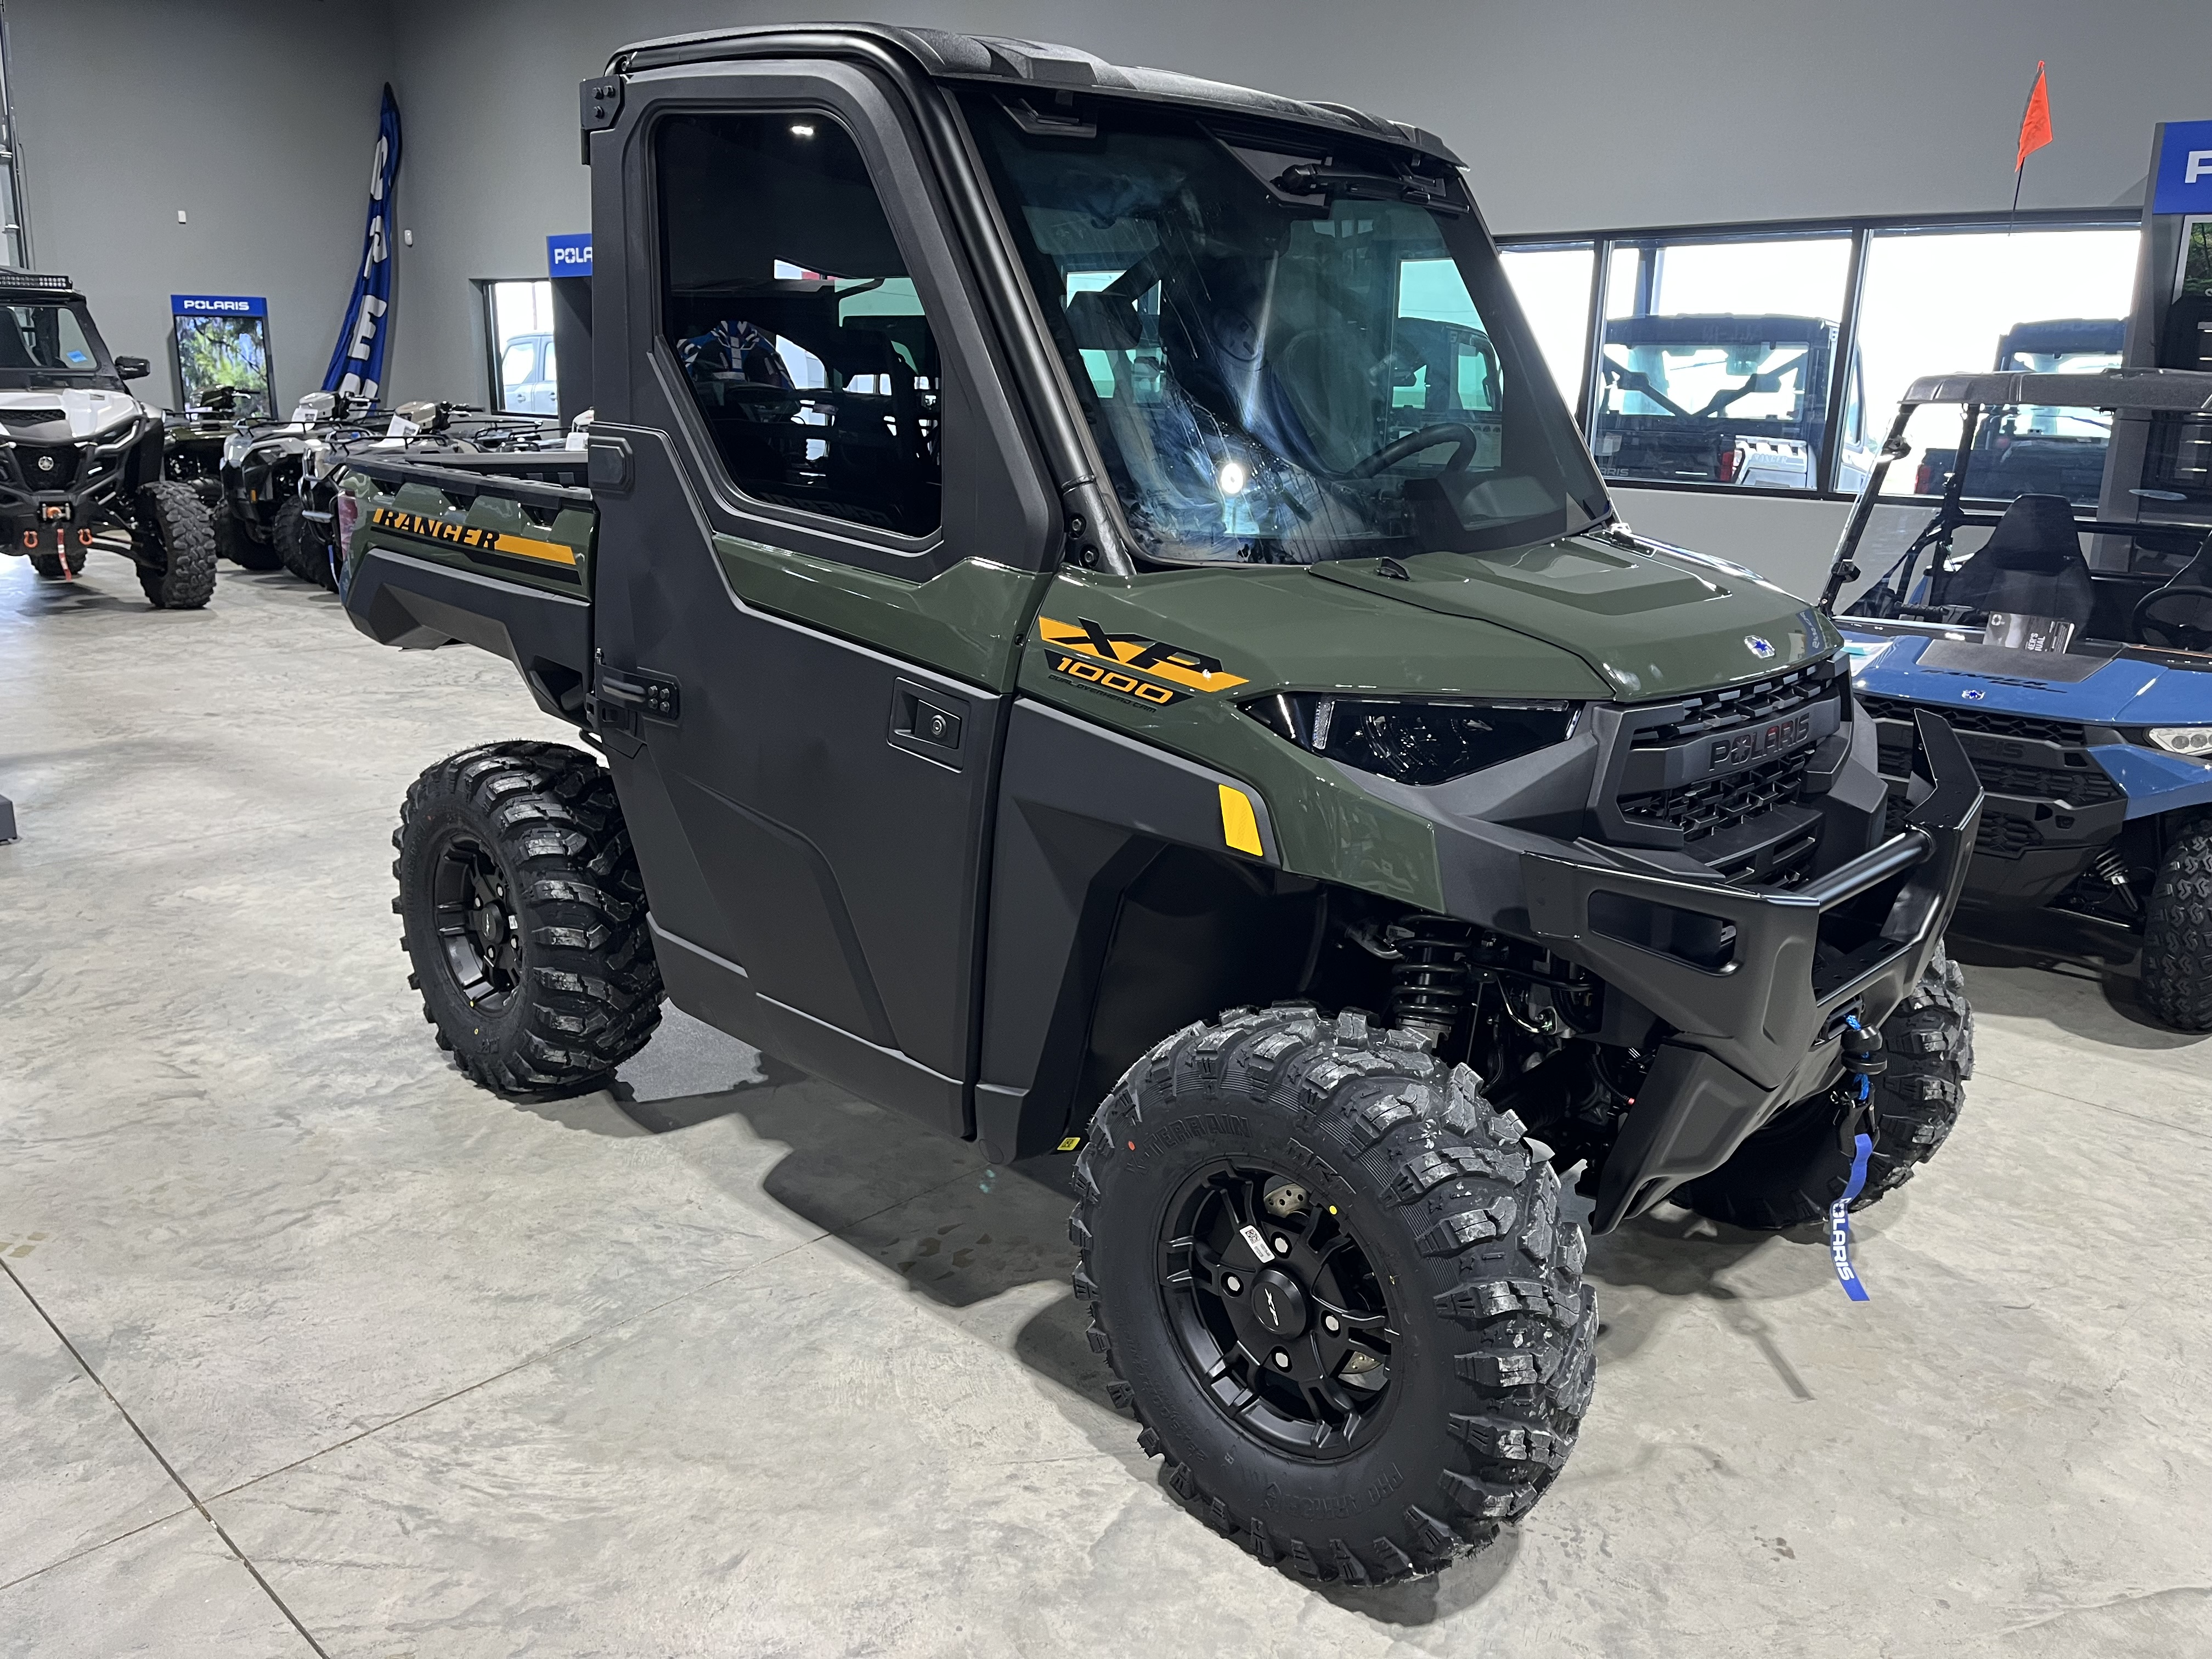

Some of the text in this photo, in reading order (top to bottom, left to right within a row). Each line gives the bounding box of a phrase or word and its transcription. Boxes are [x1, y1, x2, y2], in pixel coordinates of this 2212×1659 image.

[183, 300, 250, 311] POLARIS
[379, 509, 500, 550] RANGER
[1047, 616, 1224, 673] XP
[1048, 674, 1158, 713] DUAL OVERHEAD CAM
[1057, 657, 1173, 704] 1000
[1920, 669, 2049, 686] RANGER
[1709, 712, 1810, 771] POLARIS
